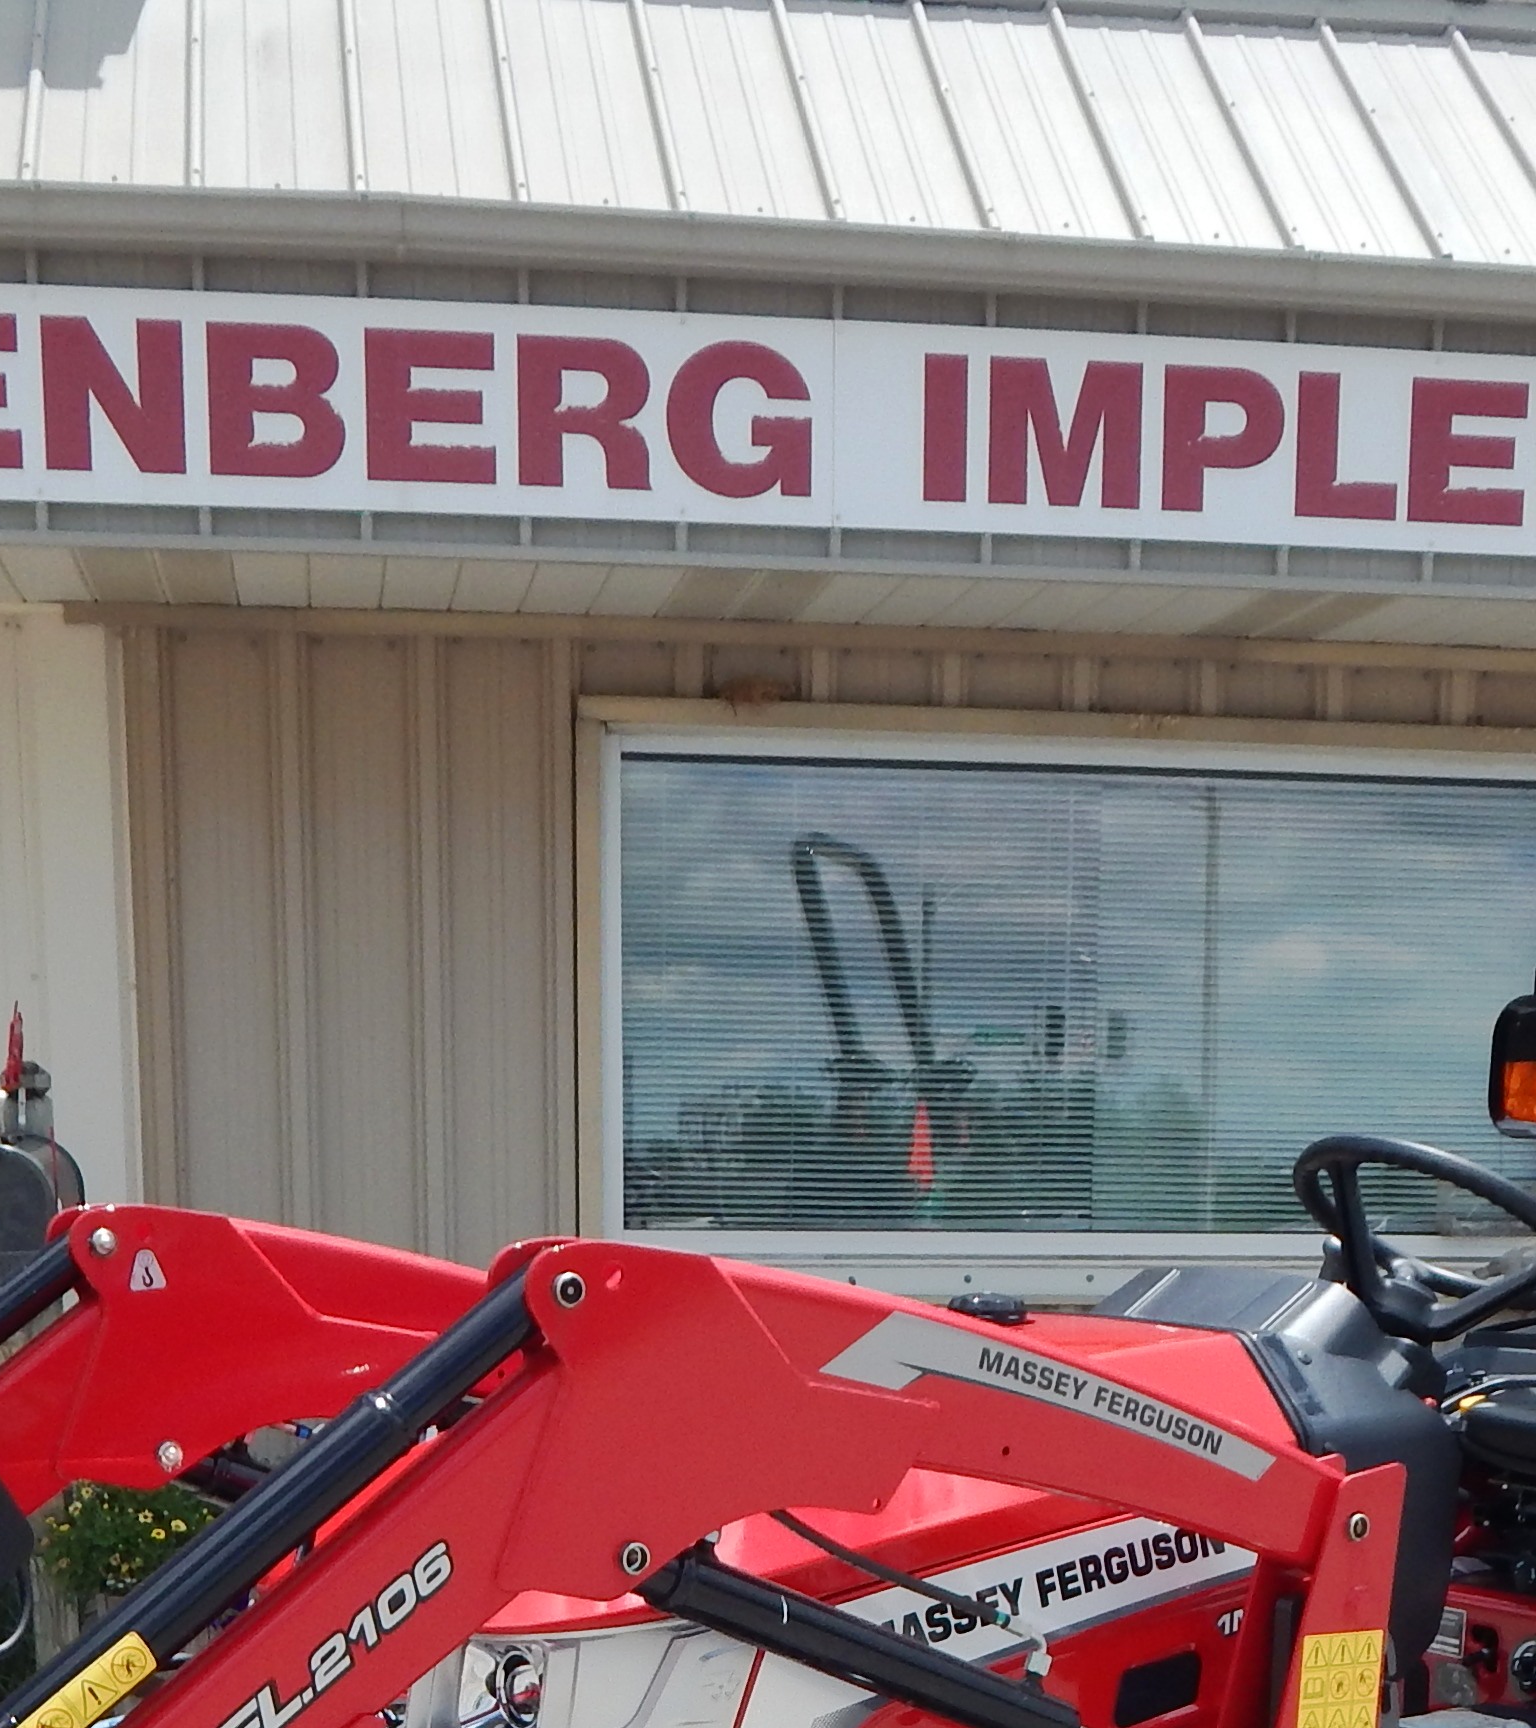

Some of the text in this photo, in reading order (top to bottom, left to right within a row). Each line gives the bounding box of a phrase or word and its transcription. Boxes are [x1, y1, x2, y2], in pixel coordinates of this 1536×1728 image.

[977, 1347, 1224, 1456] MASSEY FERGUSON
[881, 1577, 1023, 1645] ASSEY
